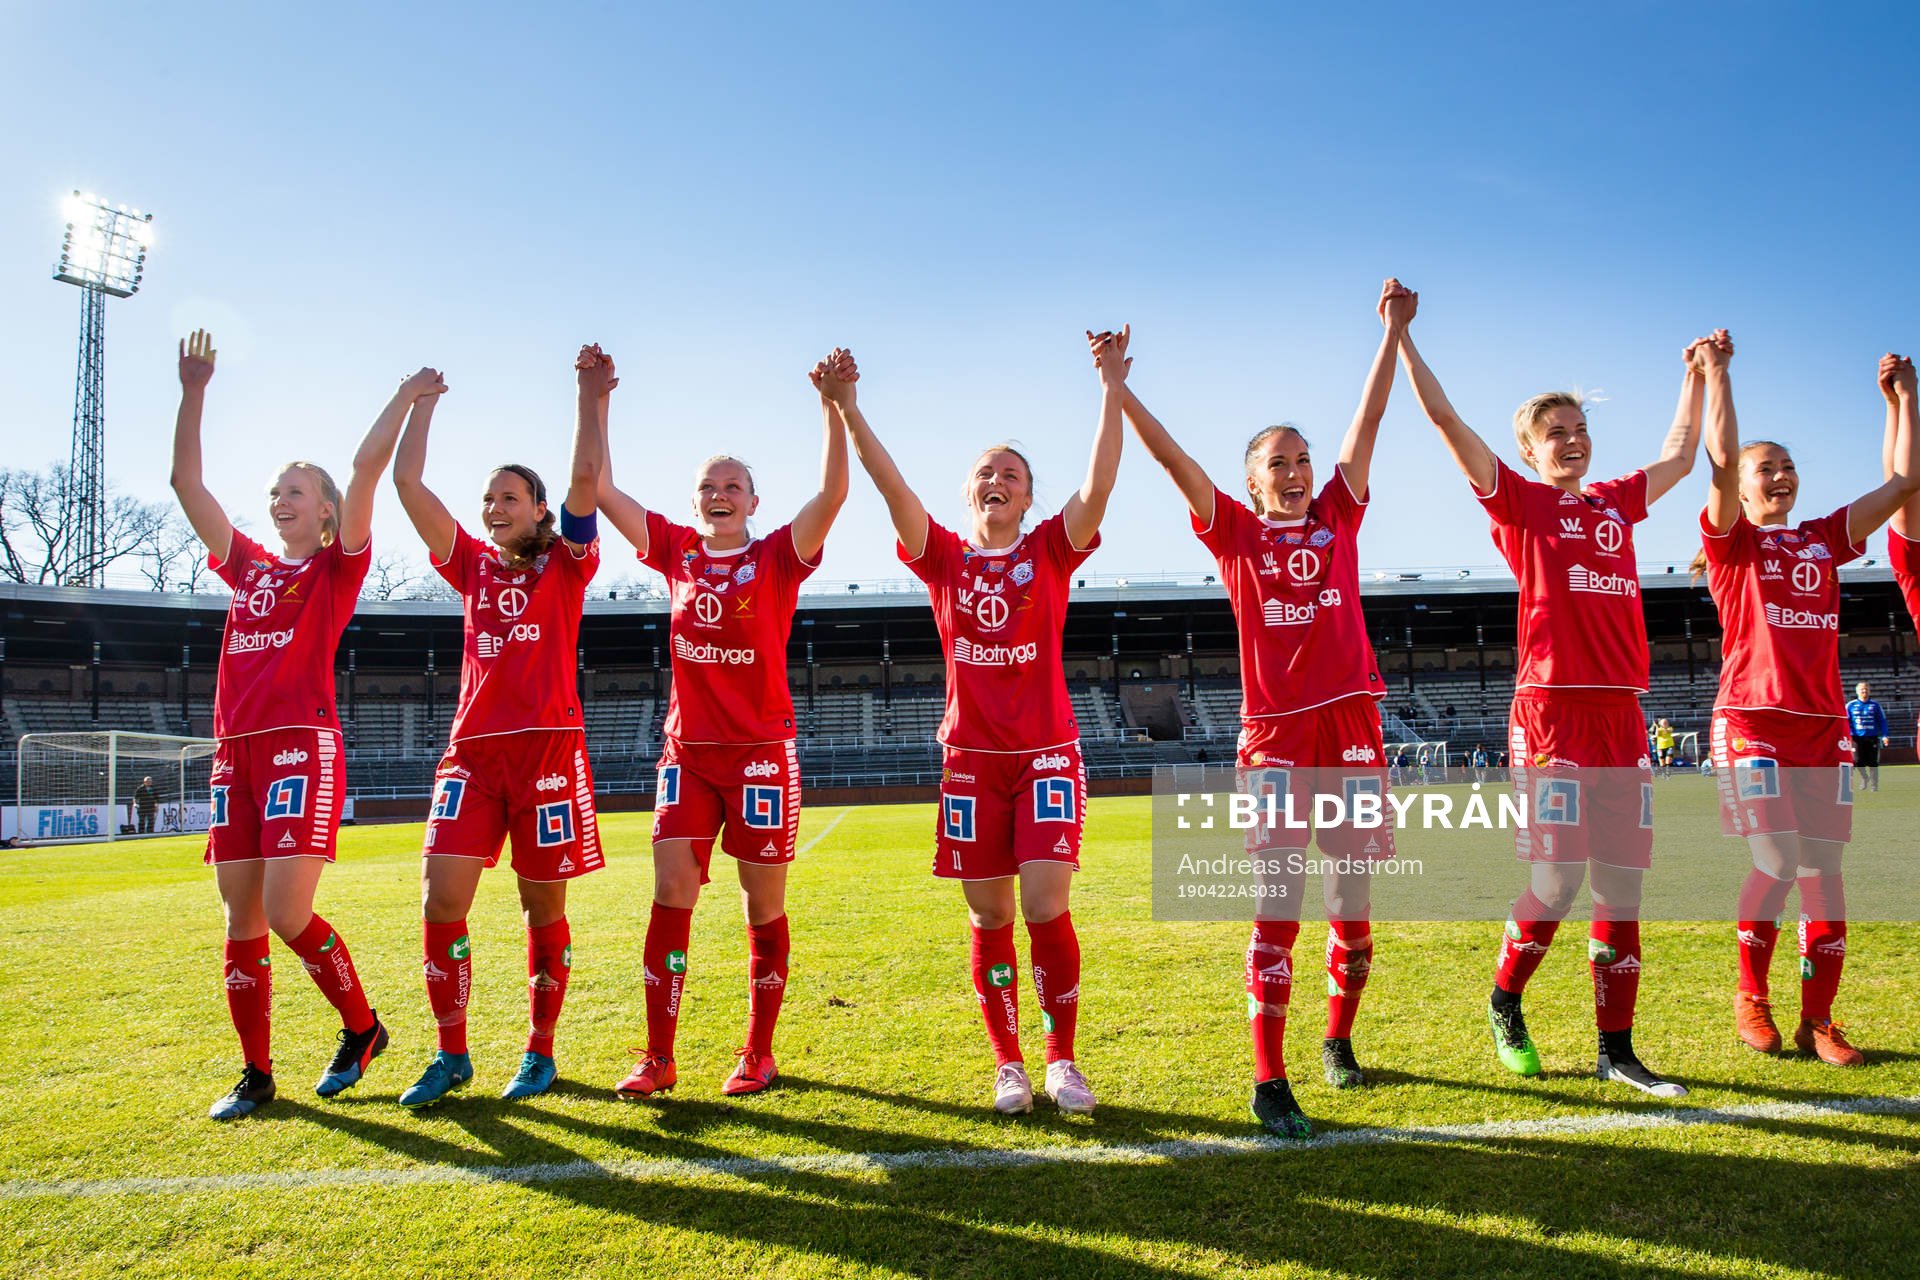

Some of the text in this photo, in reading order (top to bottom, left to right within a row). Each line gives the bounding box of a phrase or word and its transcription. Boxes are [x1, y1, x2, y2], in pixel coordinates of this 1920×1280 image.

[1589, 571, 1637, 598] Botryg
[1782, 609, 1839, 630] Botryg
[686, 642, 755, 665] Botrygg
[972, 642, 1038, 665] Botrygg
[272, 748, 308, 766] elajo
[1032, 754, 1071, 771] elajo
[1342, 744, 1376, 764] elajo
[744, 760, 780, 778] elajo
[38, 809, 98, 837] Flinks
[952, 850, 963, 871] 11
[331, 947, 353, 992] Lundbergs
[667, 975, 684, 1017] Lundbergs
[1001, 989, 1018, 1035] Lundbergs
